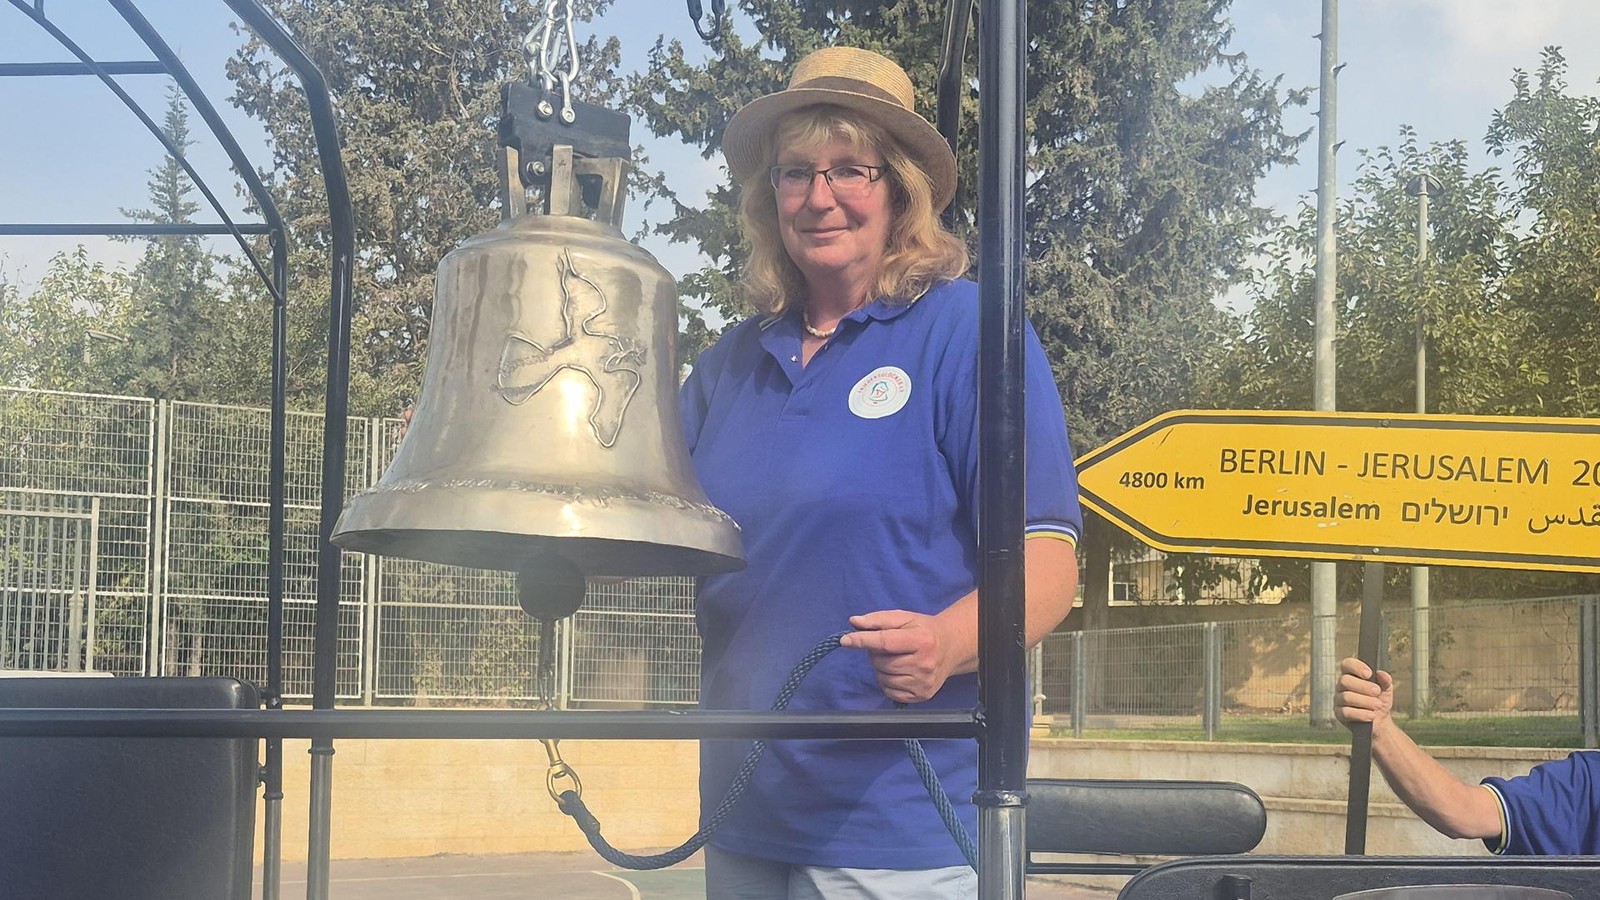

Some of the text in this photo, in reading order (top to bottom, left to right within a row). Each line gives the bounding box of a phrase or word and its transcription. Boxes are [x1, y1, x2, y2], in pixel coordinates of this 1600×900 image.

[1118, 471, 1205, 490] 4800 km
[1220, 448, 1325, 476] BERLIN
[1357, 452, 1549, 485] JERUSALEM
[1242, 494, 1381, 521] Jerusalem
[1401, 497, 1509, 526] ירושלים
